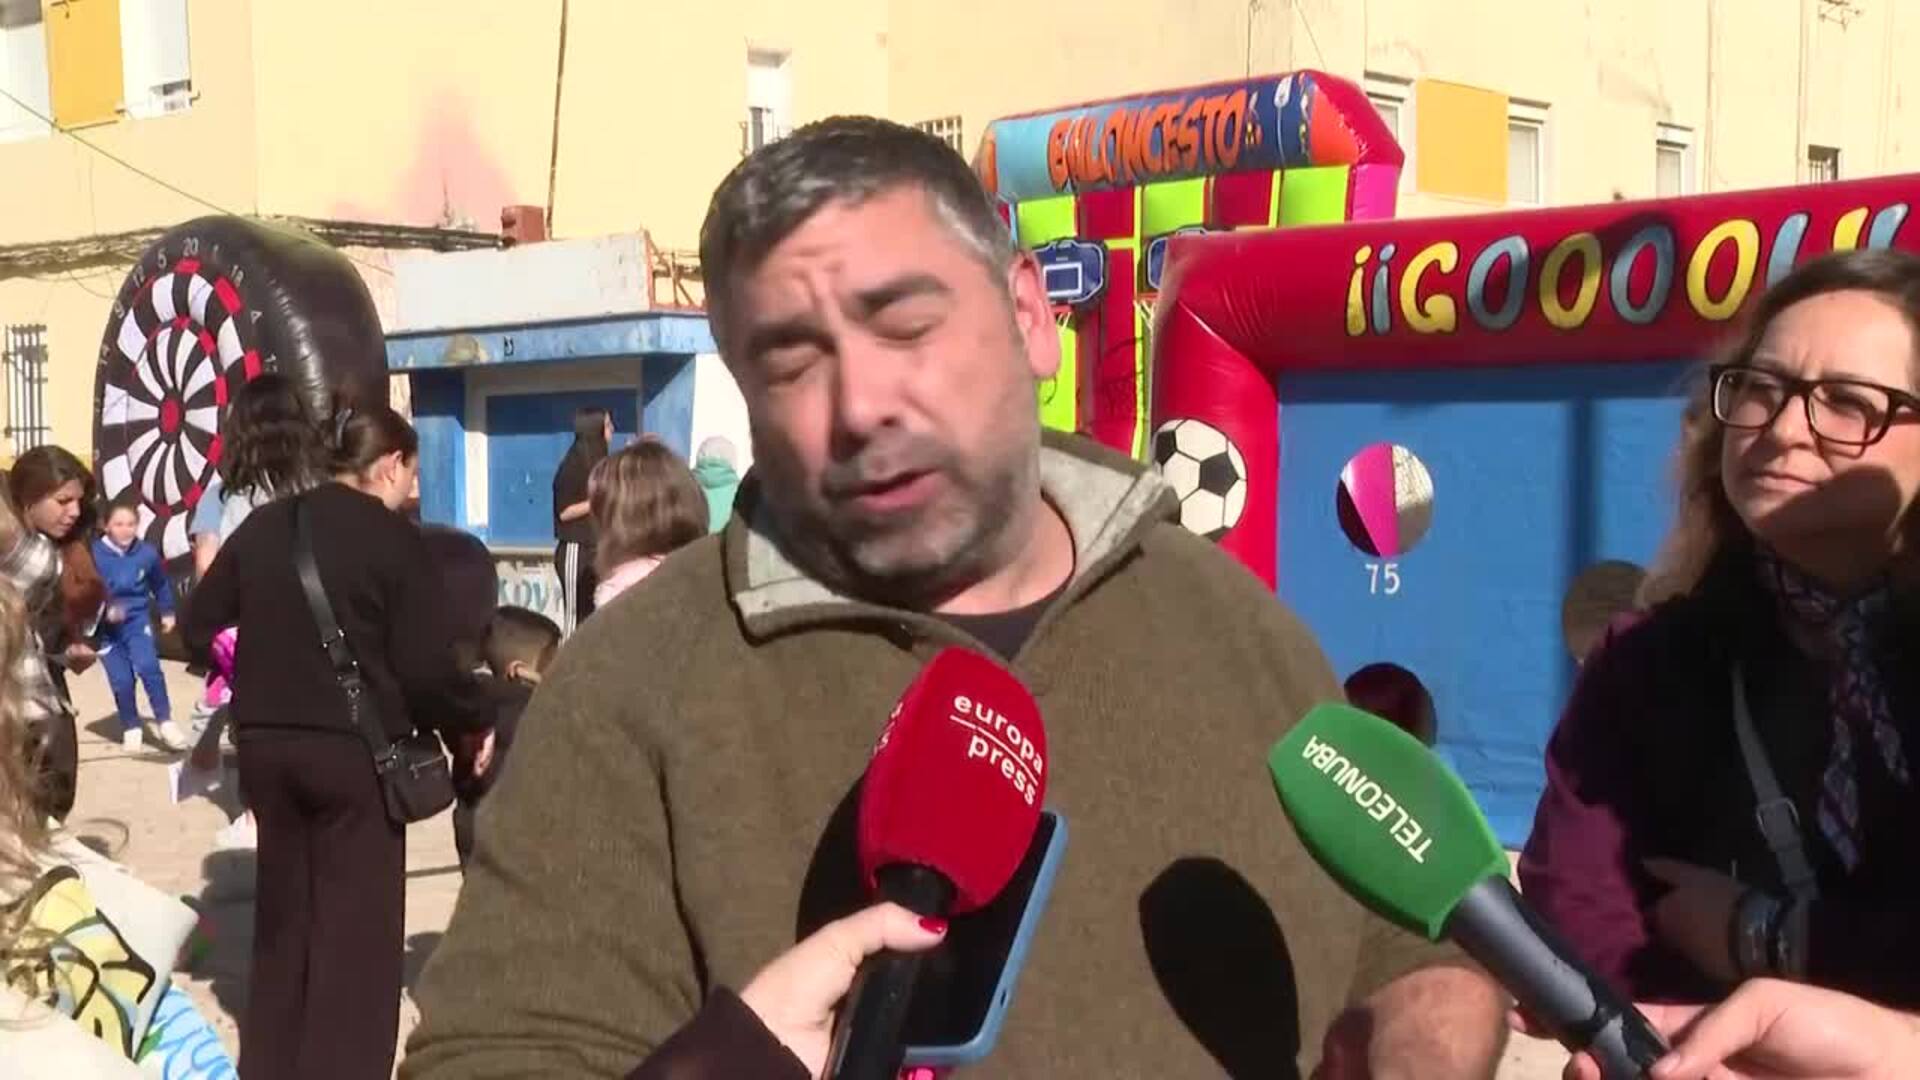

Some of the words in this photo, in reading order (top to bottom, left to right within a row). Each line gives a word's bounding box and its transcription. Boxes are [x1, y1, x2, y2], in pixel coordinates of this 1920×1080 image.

[1048, 88, 1248, 192] BALONCESTO
[157, 248, 167, 269] 5
[183, 237, 199, 256] 20
[1365, 563, 1400, 594] 75
[953, 695, 1042, 775] europa
[968, 735, 1035, 806] press
[1302, 735, 1433, 864] TELEONUBA
